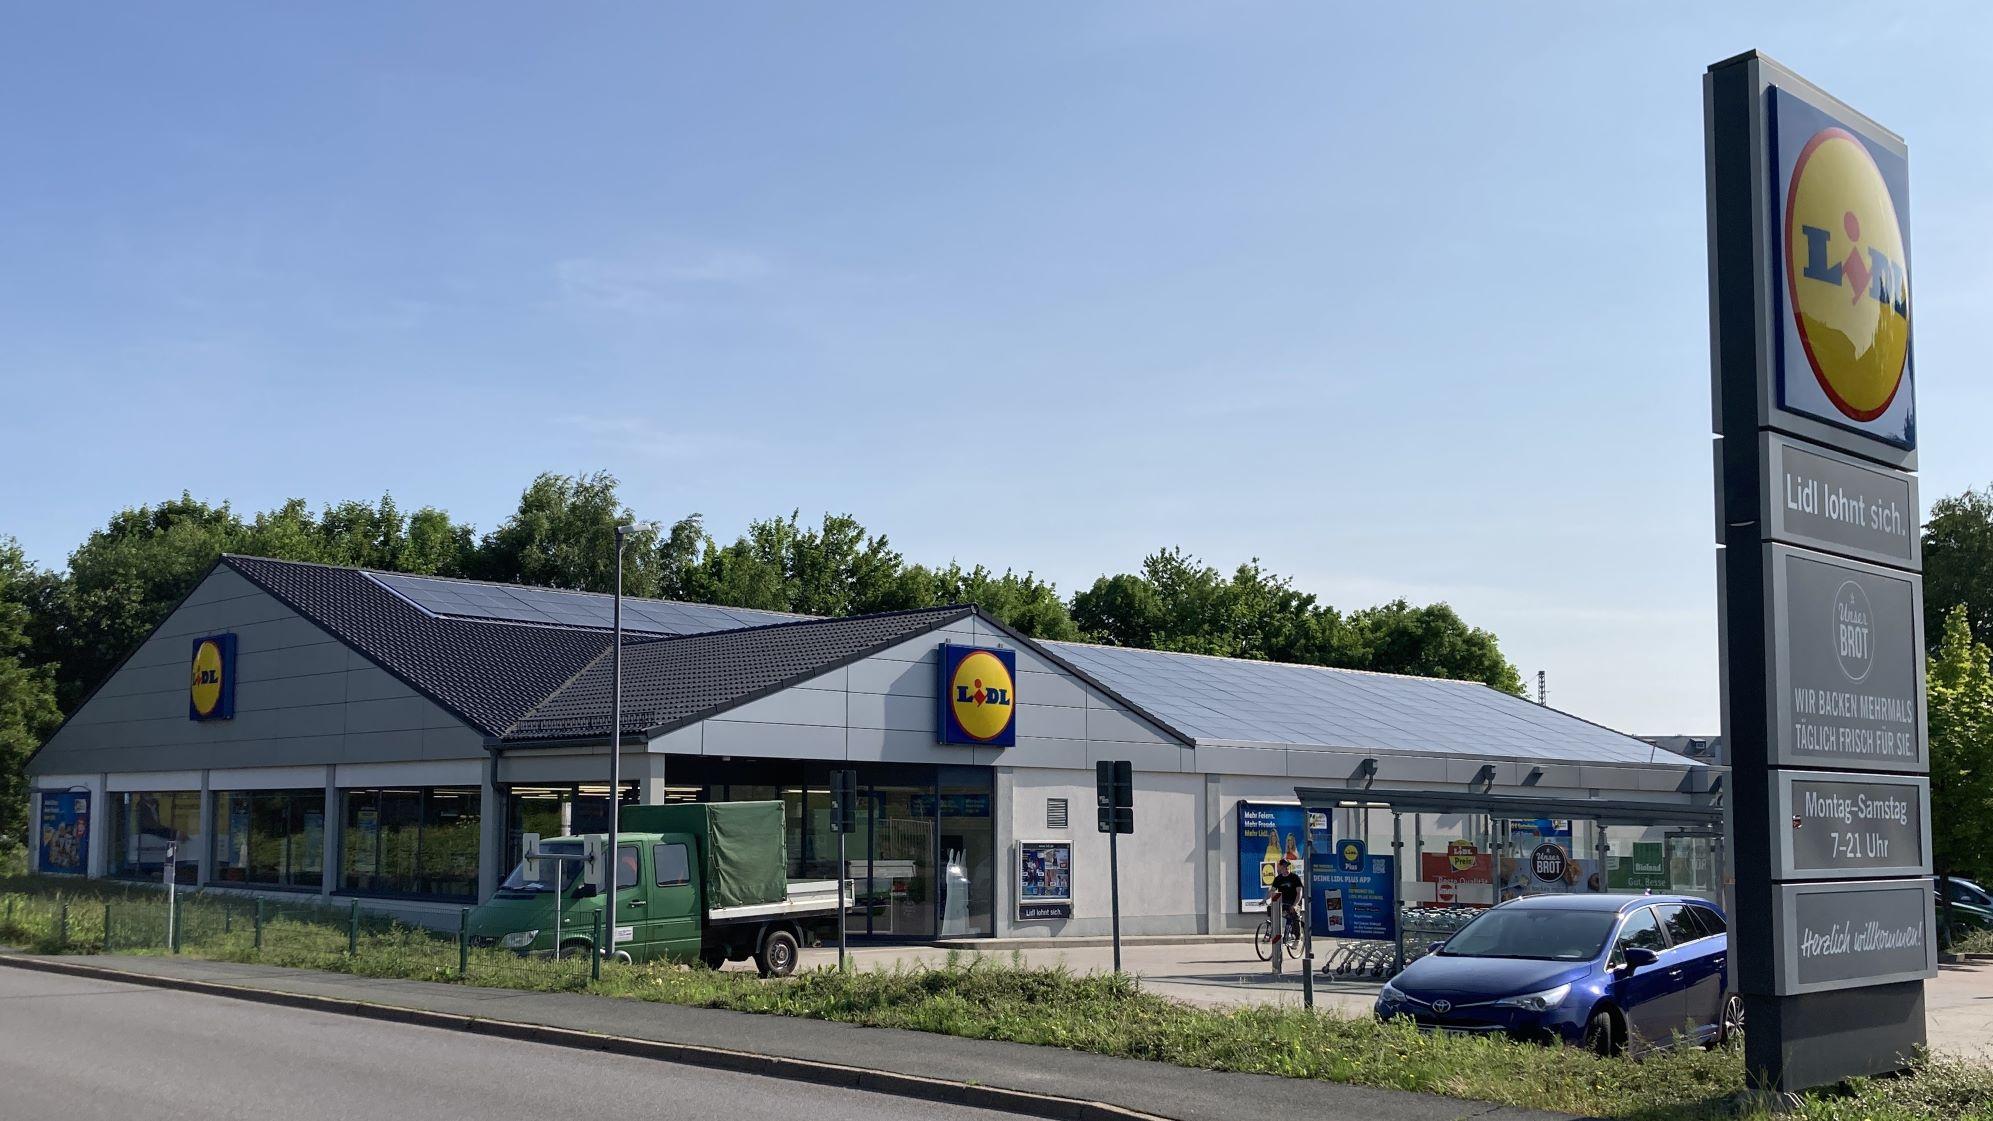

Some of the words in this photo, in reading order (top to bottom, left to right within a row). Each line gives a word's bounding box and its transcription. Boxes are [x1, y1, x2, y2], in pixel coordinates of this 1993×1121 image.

[1786, 473, 1818, 514] Lidl
[1824, 483, 1866, 527] lohnt
[1870, 499, 1906, 536] sich.
[1838, 602, 1868, 625] Unser
[1840, 624, 1869, 659] BROT
[1794, 687, 1816, 713] WIR
[1819, 690, 1857, 718] BACKEN
[1860, 695, 1913, 724] MEHRMALS
[1795, 719, 1836, 751] TÄGLICH
[1839, 727, 1874, 754] FRISCH
[1876, 726, 1894, 755] FÜR
[1897, 732, 1914, 757] SIE.
[1805, 791, 1908, 826] Montag-Samstag
[1244, 811, 1258, 819] Mehr
[1244, 820, 1258, 828] Mehr
[1830, 832, 1862, 858] 7-21
[1866, 832, 1889, 858] Uhr
[1454, 857, 1472, 865] Preis
[1536, 852, 1560, 860] Unser
[1537, 861, 1561, 873] BROT
[1635, 862, 1661, 871] Bioland
[1313, 874, 1330, 882] DEINE
[1344, 875, 1358, 883] PLUS
[1645, 878, 1666, 887] Besse
[1026, 909, 1036, 917] Lidl
[1036, 908, 1050, 916] lohnt
[1801, 920, 1850, 958] Herzlich
[1854, 920, 1923, 952] willkommen!
